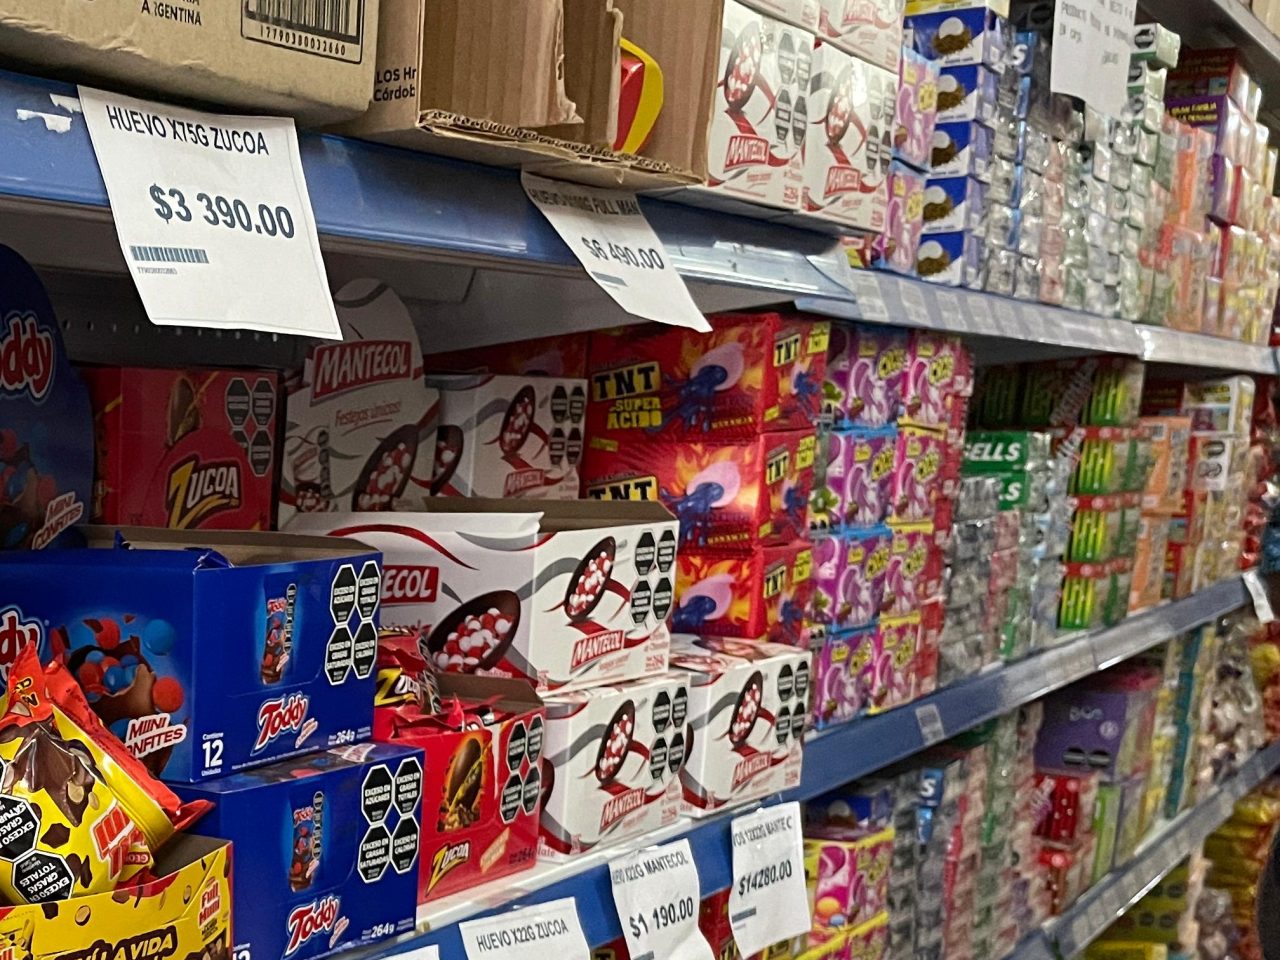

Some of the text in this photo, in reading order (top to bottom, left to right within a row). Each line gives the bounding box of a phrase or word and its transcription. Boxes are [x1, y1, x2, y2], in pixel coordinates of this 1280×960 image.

[106, 105, 269, 155] HUEVO X75G ZUCOA
[149, 183, 295, 239] $3 390.00
[609, 242, 665, 270] 490.00
[776, 335, 801, 366] TNT
[317, 345, 410, 393] MANTECOL
[593, 365, 657, 400] TNT
[571, 631, 623, 669] MANTECOL
[258, 694, 308, 751] Toddy
[202, 739, 224, 768] 12
[600, 788, 645, 832] MANTECOL
[2, 820, 35, 845] EXCESO
[19, 862, 57, 887] TOTALES
[425, 840, 471, 897] ZUCOA
[644, 851, 689, 875] MANTECOL
[738, 858, 793, 897] $14280.00
[27, 871, 59, 894] GRASAS
[287, 896, 340, 955] Toddy
[371, 922, 395, 937] 264g
[476, 918, 569, 953] HUEVO X22G ZUCOA
[629, 896, 694, 941] $1 190.00
[129, 932, 175, 960] VIDA
